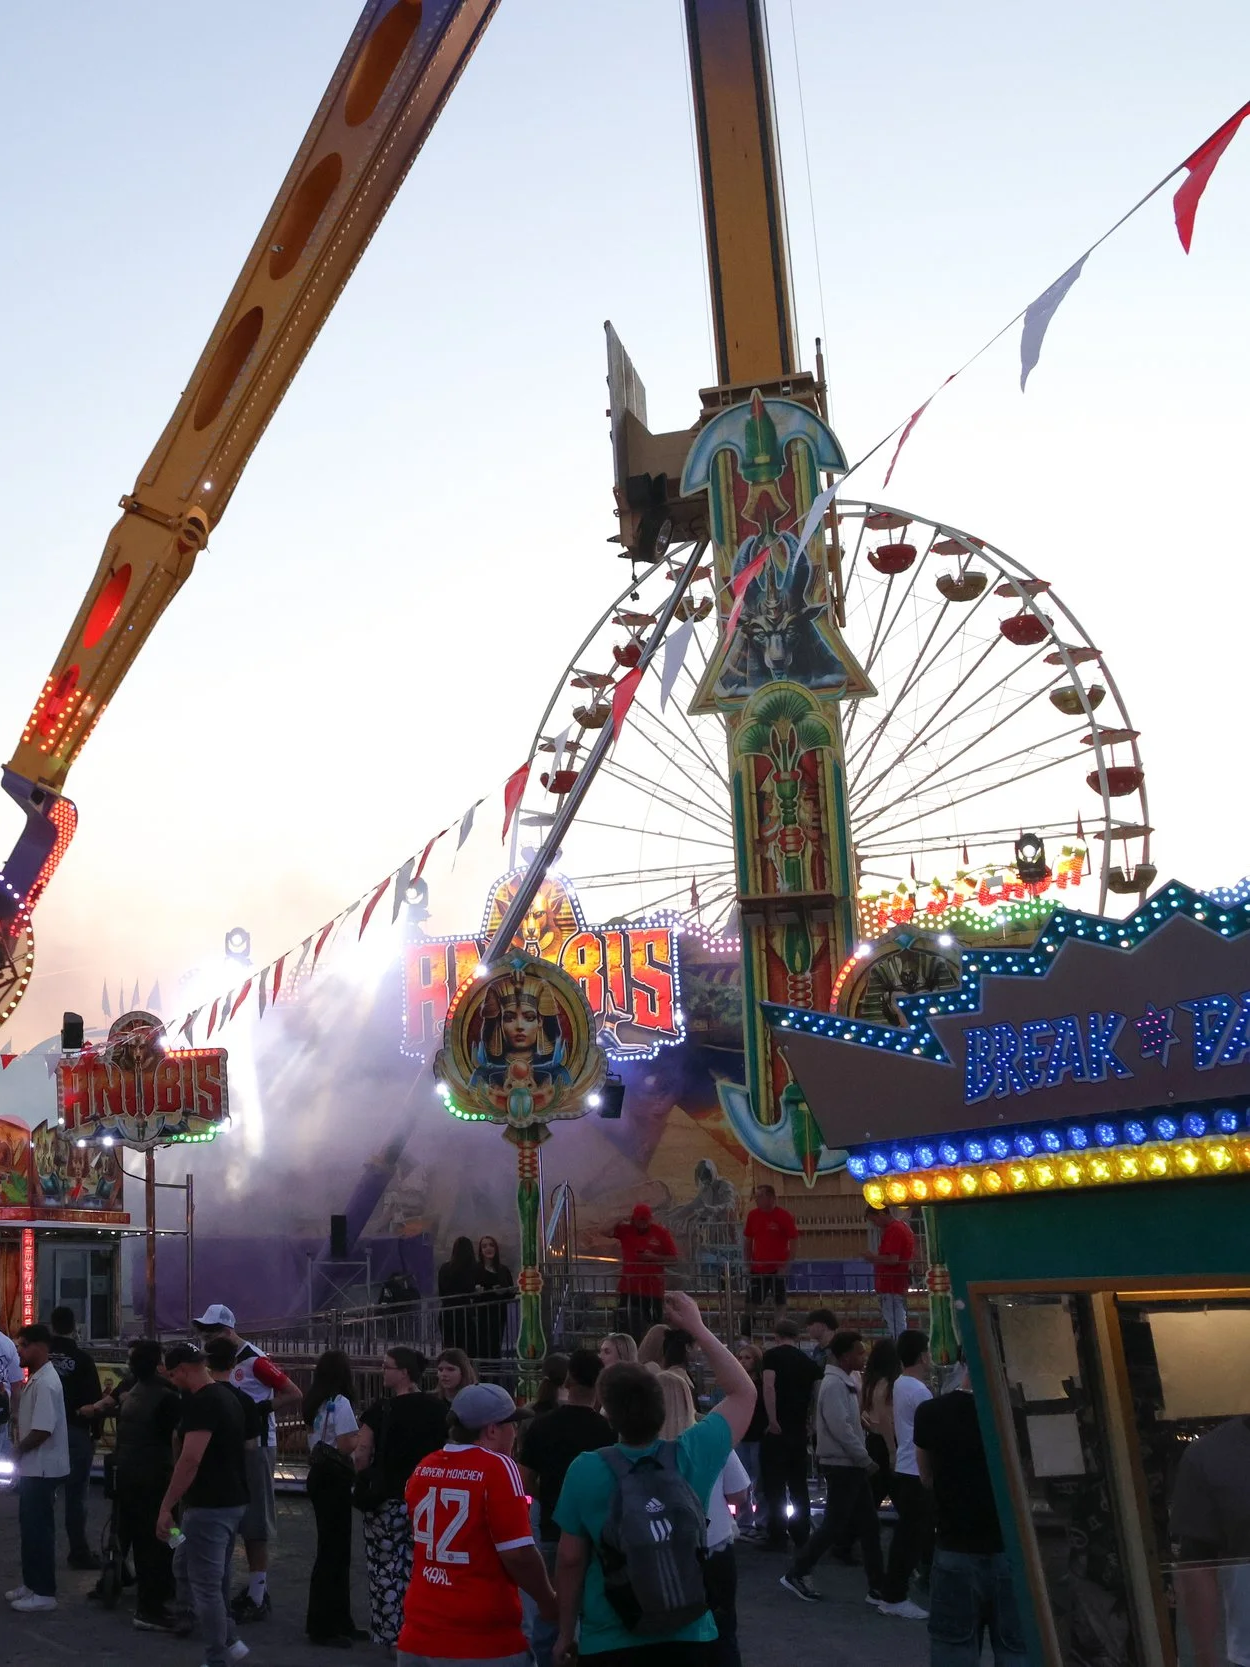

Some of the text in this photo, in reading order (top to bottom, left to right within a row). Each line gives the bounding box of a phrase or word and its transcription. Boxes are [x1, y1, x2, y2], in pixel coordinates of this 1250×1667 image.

[60, 1055, 224, 1131] ANUBIS
[962, 1011, 1134, 1106] BREAK
[420, 1466, 446, 1478] BAYERN
[413, 1486, 470, 1564] 42
[422, 1566, 452, 1586] KARL
